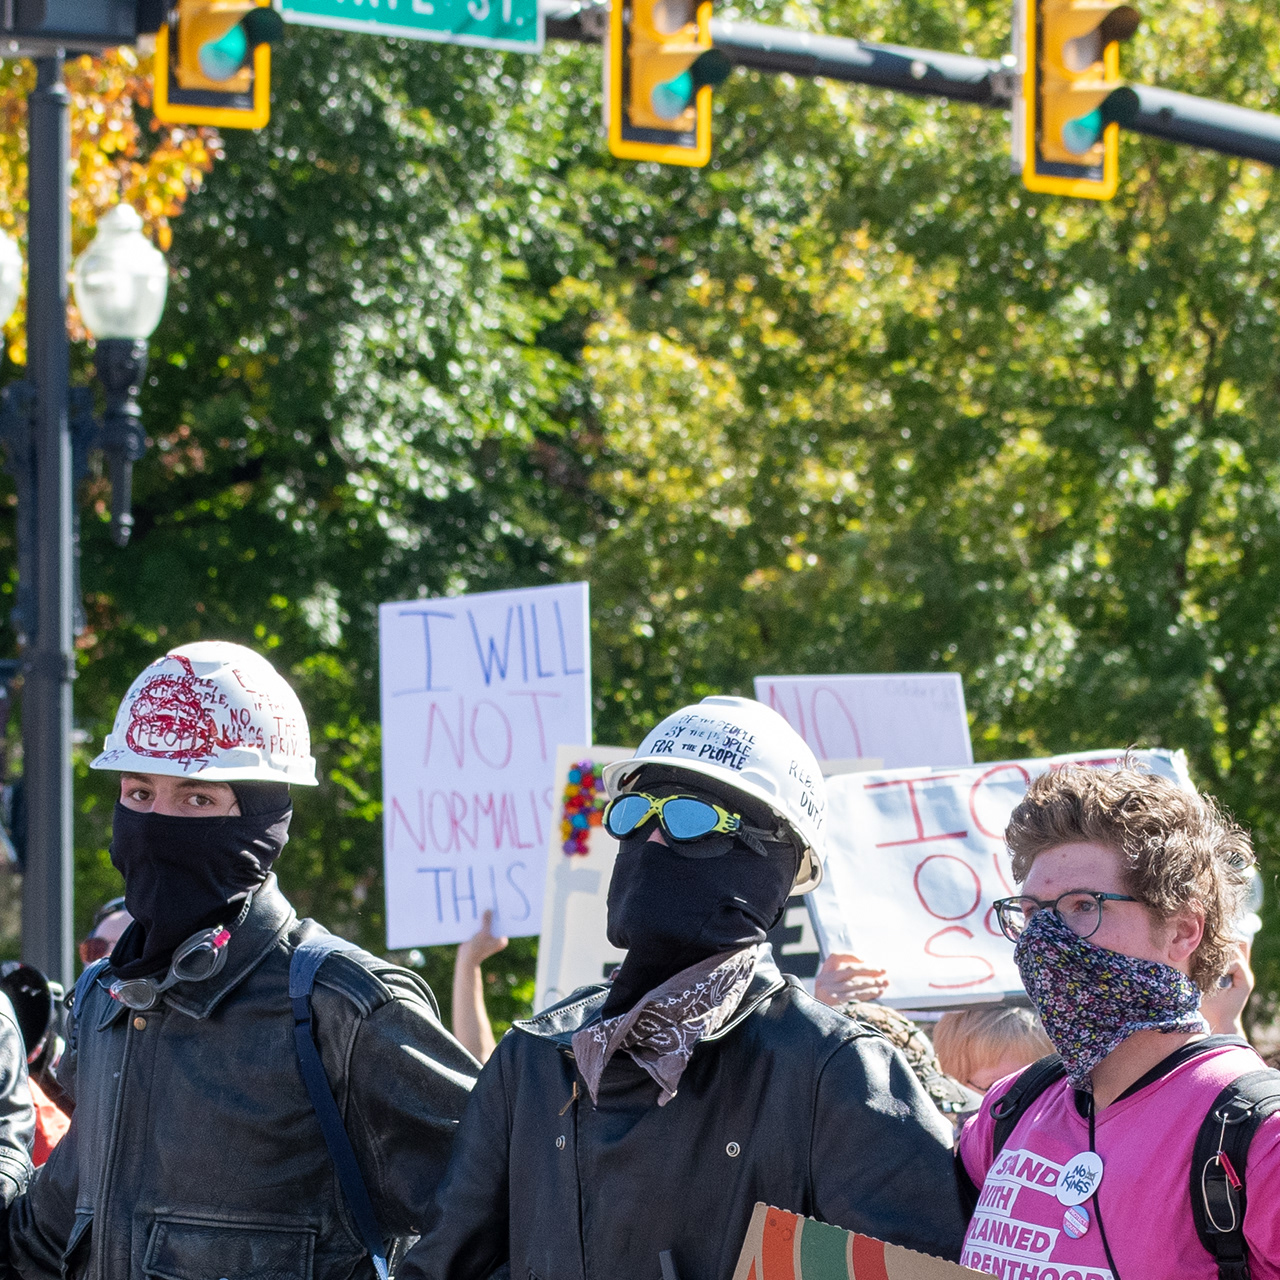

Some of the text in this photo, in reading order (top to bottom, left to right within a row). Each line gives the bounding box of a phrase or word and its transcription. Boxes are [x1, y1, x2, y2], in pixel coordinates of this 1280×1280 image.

[391, 599, 583, 697] I WILL
[230, 707, 251, 729] NO
[423, 690, 561, 770] NOT
[650, 740, 747, 771] FOR THE PEOPLE
[416, 861, 532, 924] THIS
[1061, 1171, 1091, 1196] KINGS
[1073, 1164, 1087, 1178] NO
[978, 1184, 1014, 1211] WITH
[971, 1217, 1051, 1253] PLANNED
